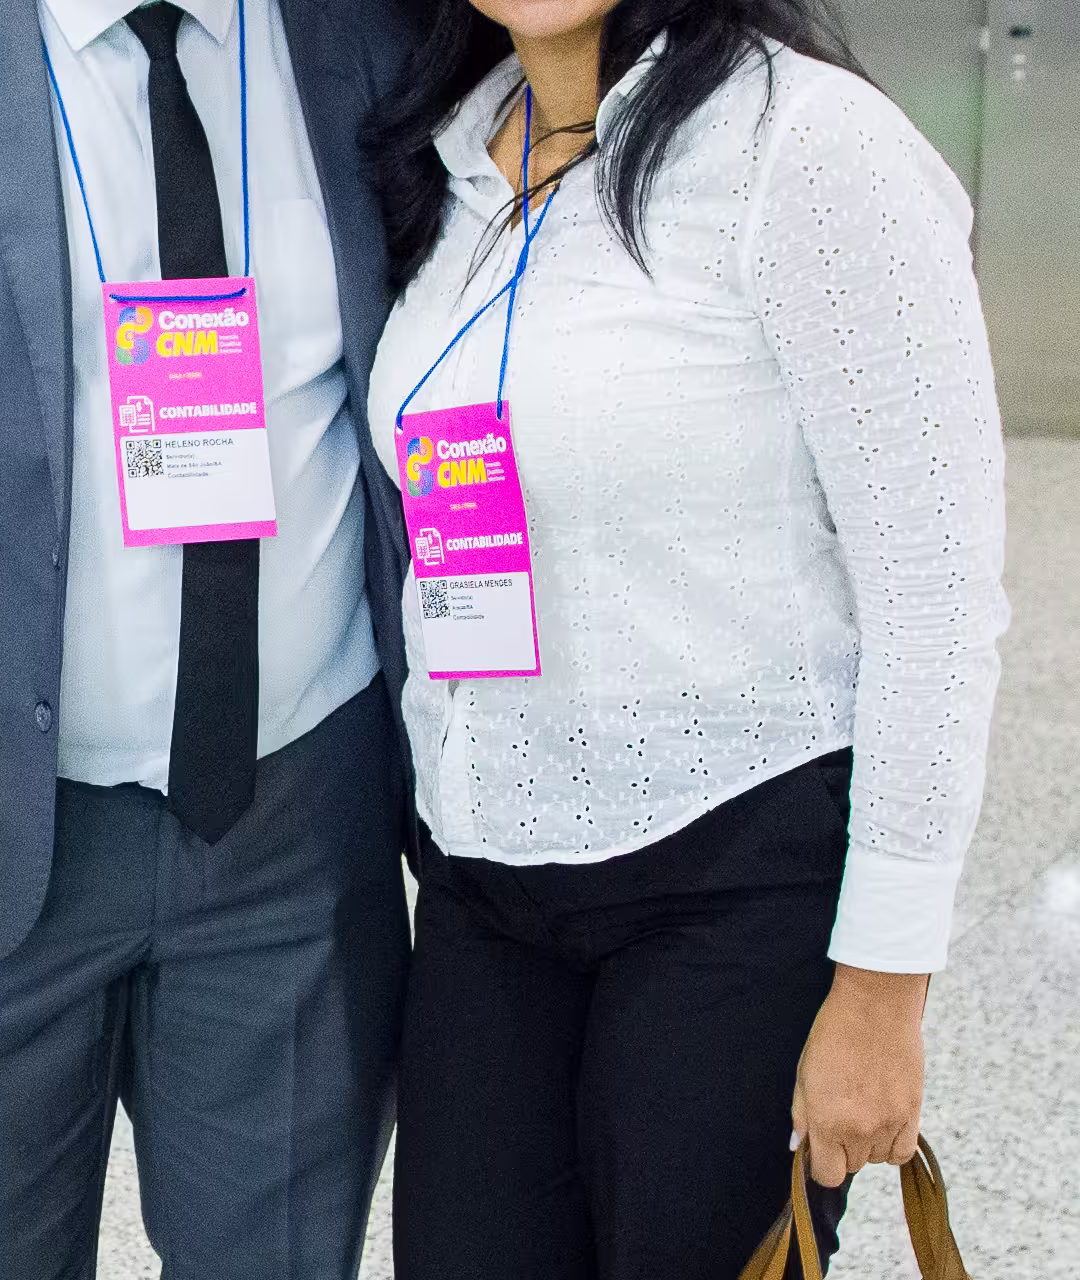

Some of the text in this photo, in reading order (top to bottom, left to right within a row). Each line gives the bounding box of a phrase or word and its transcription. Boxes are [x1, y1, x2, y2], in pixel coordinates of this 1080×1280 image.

[159, 308, 249, 330] Conexão
[156, 330, 218, 357] CNM
[160, 402, 257, 418] CONTABILIDADE
[165, 438, 234, 448] HELENO ROCHA
[437, 433, 507, 460] Conexão
[438, 458, 487, 488] CNM
[446, 532, 523, 551] CONTABILIDADE
[484, 578, 513, 588] MENDES
